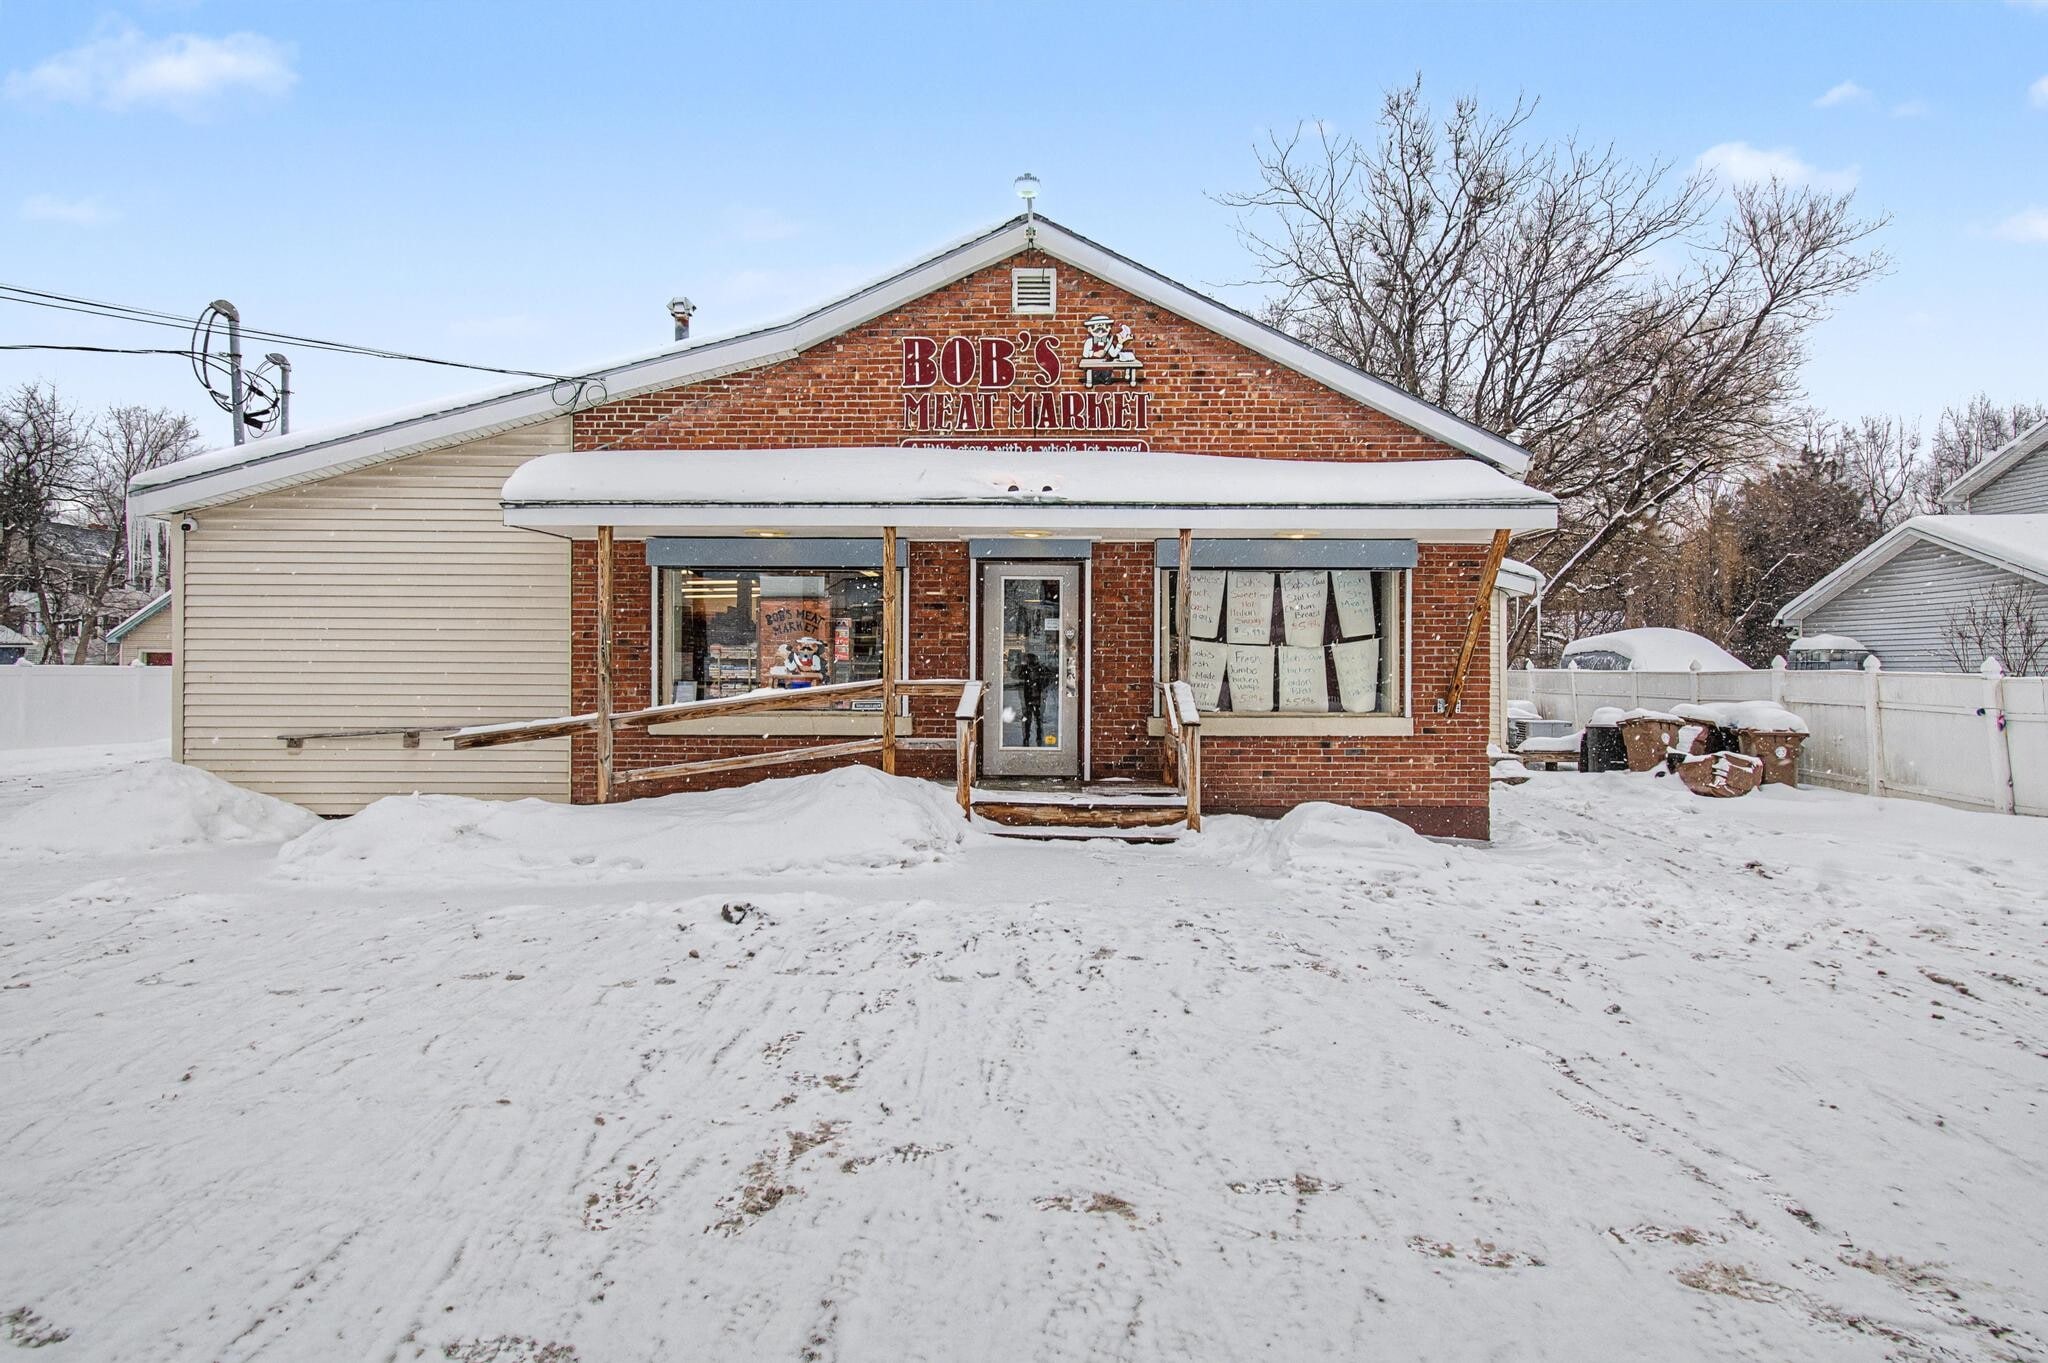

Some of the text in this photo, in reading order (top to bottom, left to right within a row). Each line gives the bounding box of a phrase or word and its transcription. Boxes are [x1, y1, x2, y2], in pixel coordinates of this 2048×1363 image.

[902, 331, 1061, 389] BOB'S
[903, 392, 1152, 431] MEAT MARKET
[993, 442, 1023, 453] with
[1039, 442, 1077, 453] whole
[1082, 442, 1100, 453] lot
[1105, 442, 1142, 453] more!
[765, 608, 826, 626] BOB'S MEAT
[772, 621, 820, 637] MARKET
